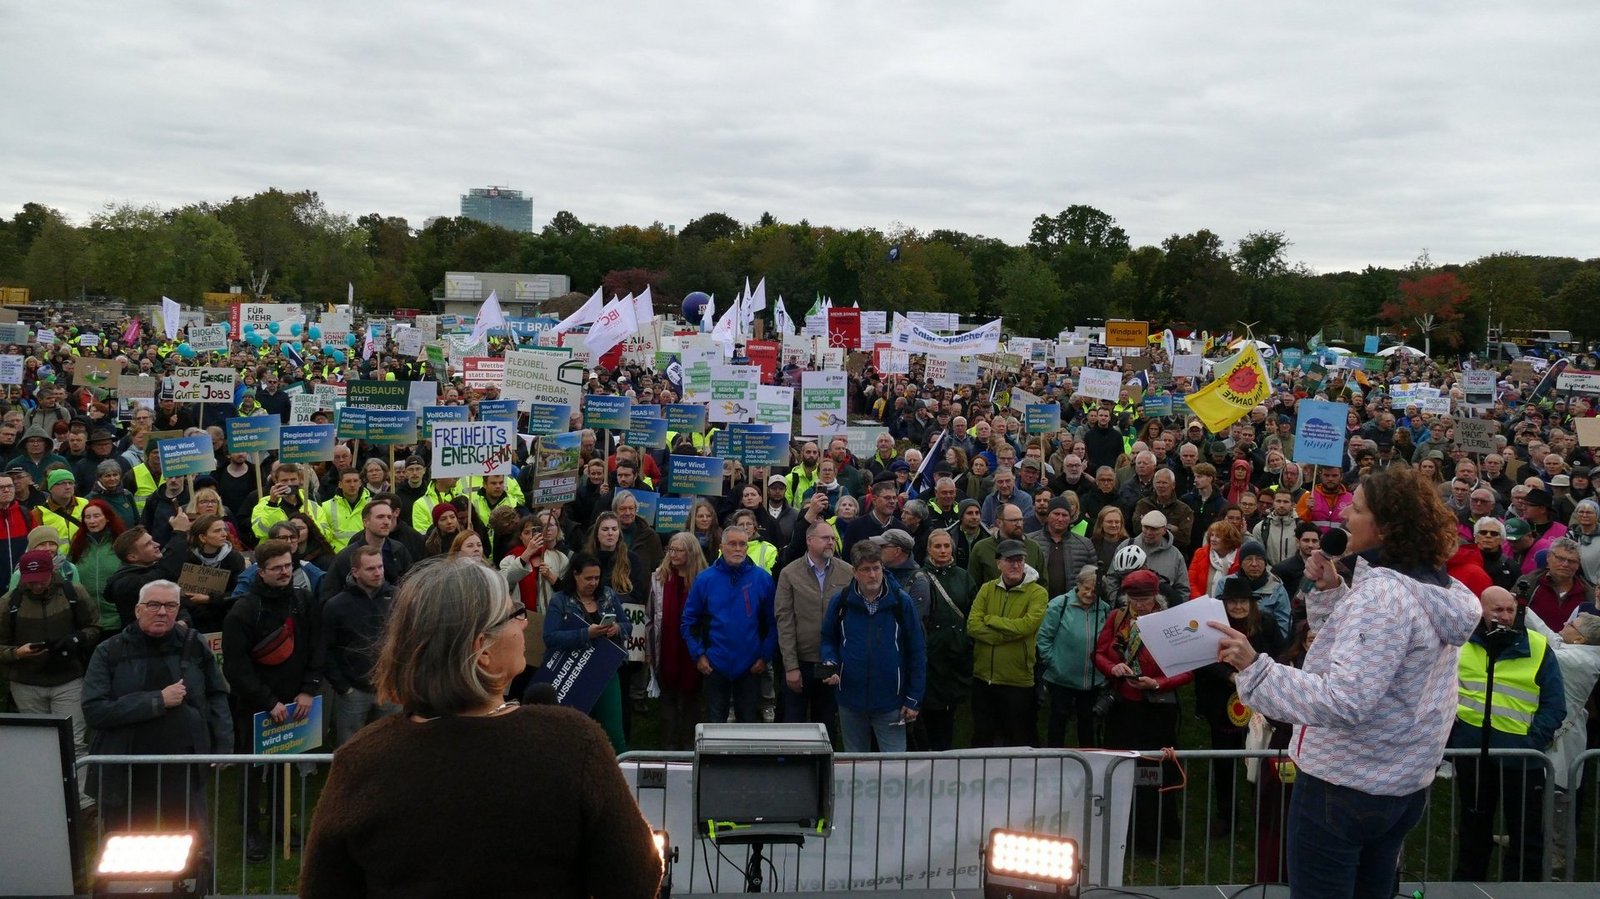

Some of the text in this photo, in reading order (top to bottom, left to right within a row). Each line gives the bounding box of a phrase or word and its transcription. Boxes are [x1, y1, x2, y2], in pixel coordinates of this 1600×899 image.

[248, 306, 264, 314] FÜR
[248, 314, 272, 322] MEHR
[192, 328, 220, 338] BIOGAS
[1110, 328, 1142, 336] Windpark
[508, 357, 548, 370] FLEXIBEL.
[176, 368, 232, 384] GUTE ENERGIE
[506, 368, 552, 382] REGIONAL.
[202, 385, 231, 399] JOBS
[350, 386, 405, 395] AUSBAUEN
[505, 380, 569, 395] SPEICHERBAR.
[174, 390, 200, 400] GUTE
[535, 395, 568, 404] #BIOGAS
[588, 400, 613, 408] Regional
[673, 468, 710, 476] ausbremst,
[199, 567, 231, 578] ZUKUNFT
[1162, 625, 1183, 639] BEE
[627, 636, 645, 651] BAR
[262, 732, 294, 747] wird es
